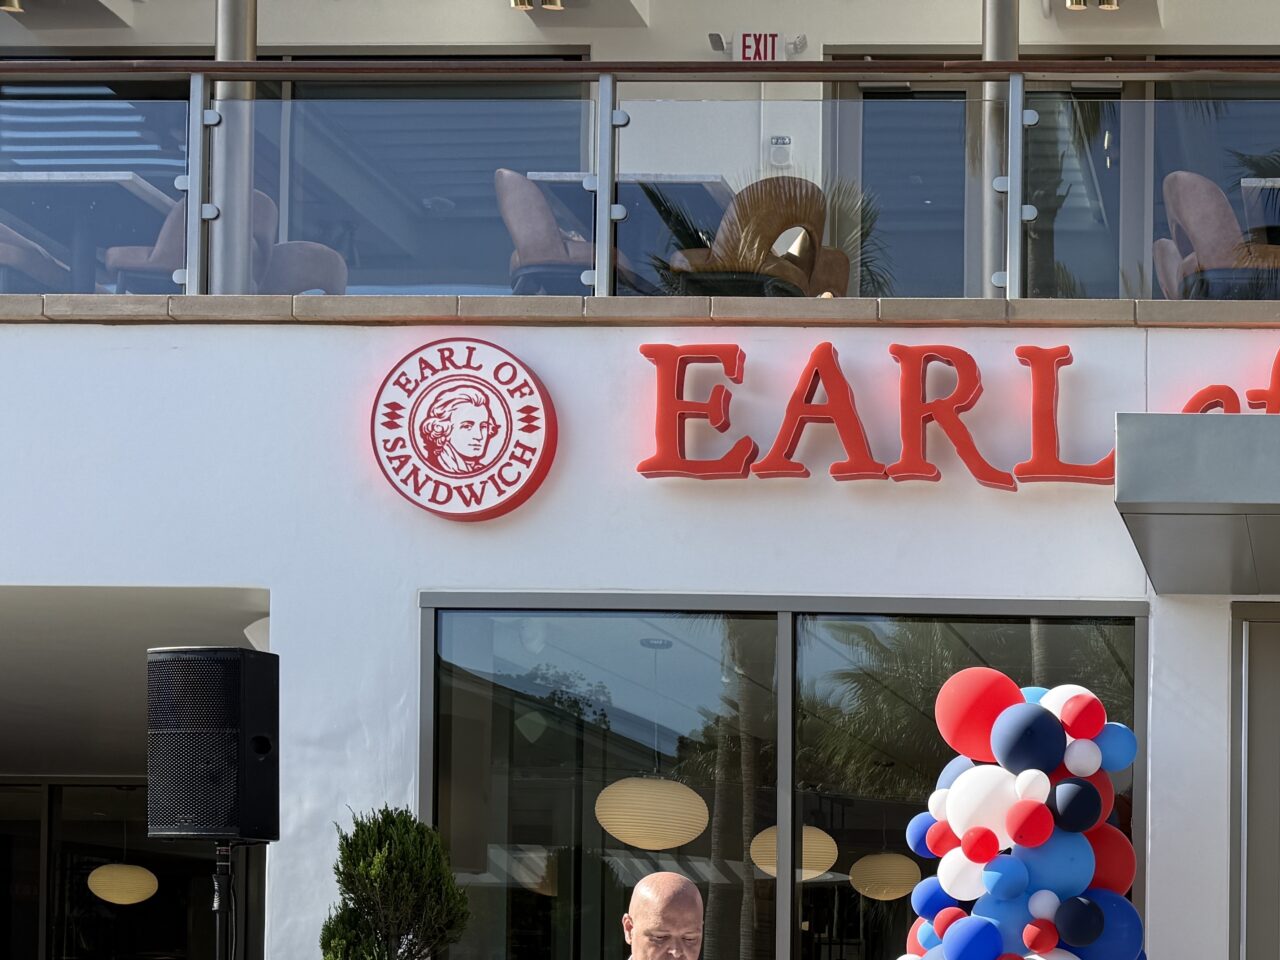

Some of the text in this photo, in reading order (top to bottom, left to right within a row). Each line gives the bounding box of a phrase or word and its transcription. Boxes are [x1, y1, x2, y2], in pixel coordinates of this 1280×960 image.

[742, 33, 778, 61] EXIT
[393, 346, 534, 399] EARL OF
[637, 342, 1116, 491] EARL
[382, 436, 537, 508] SANDWICH
